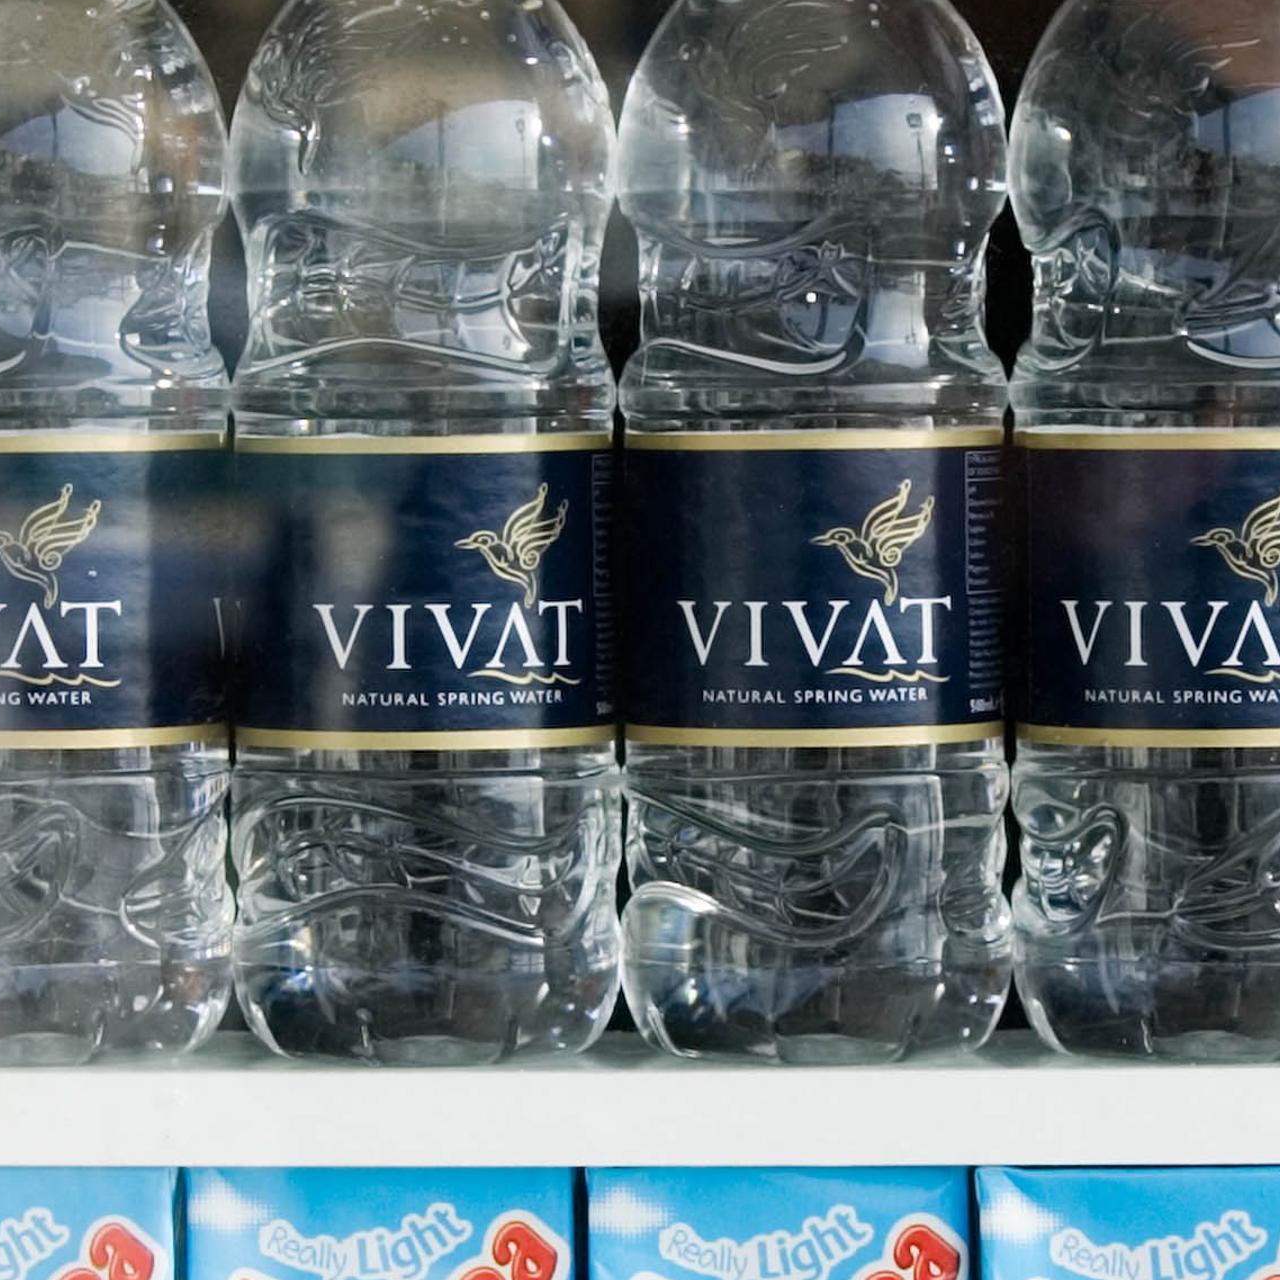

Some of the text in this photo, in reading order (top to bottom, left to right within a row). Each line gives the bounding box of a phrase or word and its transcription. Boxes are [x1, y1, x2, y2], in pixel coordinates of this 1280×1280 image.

[314, 598, 582, 670] VIVAT
[677, 595, 952, 667] VIVAT
[27, 690, 92, 706] WATER
[703, 686, 928, 705] NATURAL SPRING WATER
[1085, 688, 1165, 704] NATURAL
[1173, 689, 1242, 705] SPRING
[758, 1211, 868, 1280] Light
